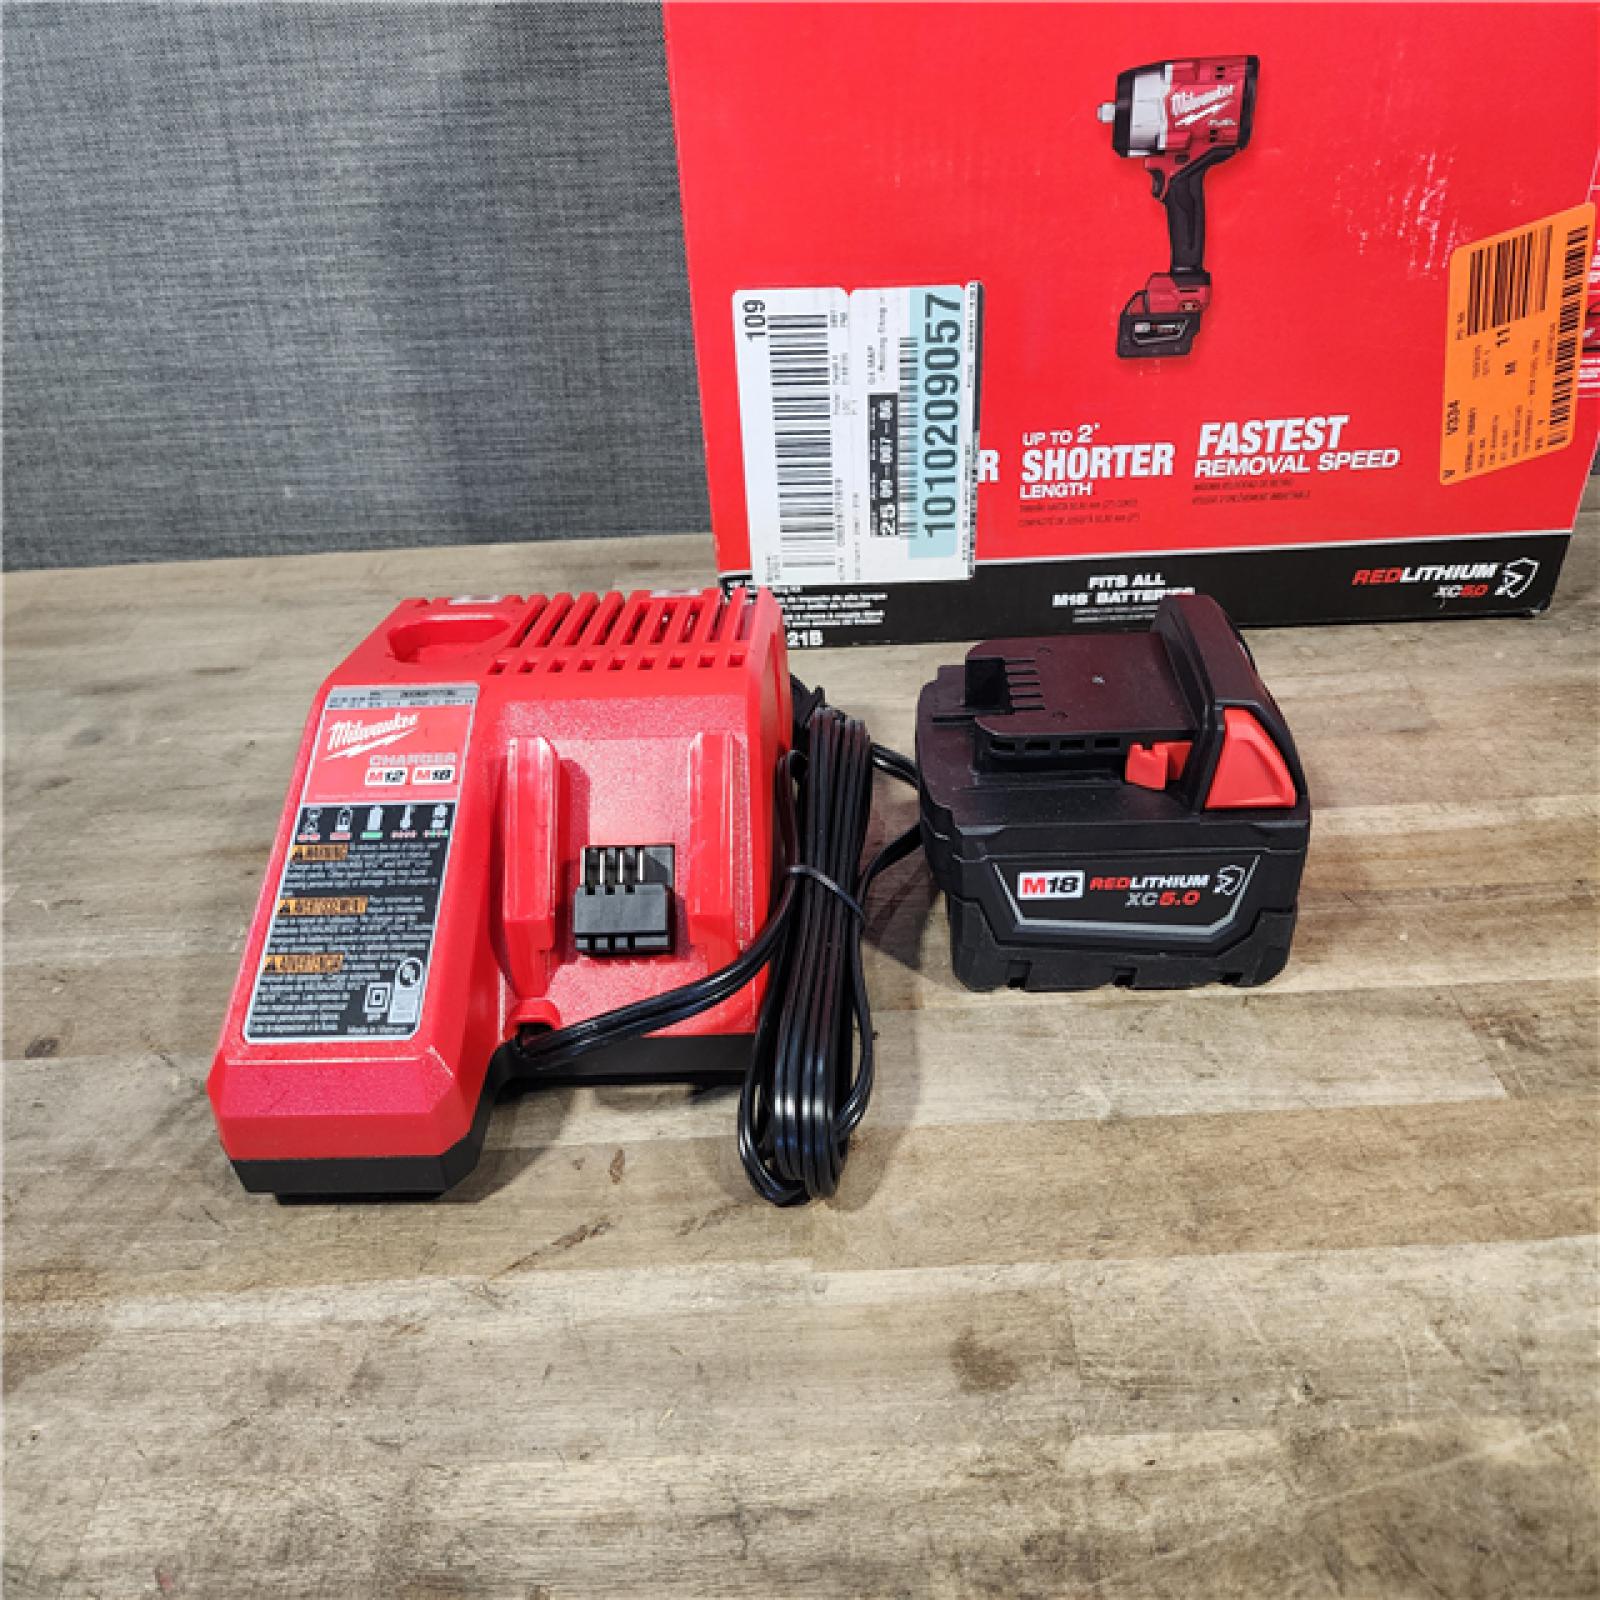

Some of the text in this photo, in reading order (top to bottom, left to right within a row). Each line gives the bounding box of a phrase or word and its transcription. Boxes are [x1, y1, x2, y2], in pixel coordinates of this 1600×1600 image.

[742, 299, 766, 342] 109
[923, 291, 961, 538] 1010209057
[1022, 431, 1046, 446] UP
[1050, 429, 1073, 444] TO
[1196, 414, 1350, 457] FASTEST
[1020, 441, 1176, 483] SHORTER
[1193, 447, 1401, 478] REMOVAL SPEED
[1019, 482, 1093, 499] LENGTH
[1088, 571, 1166, 590] FITS ALL
[1351, 563, 1502, 585] REDLITHIUM
[326, 710, 421, 751] Milwaukee
[369, 752, 457, 767] CHARGER
[1021, 872, 1212, 896] M18 REDLITHIUM
